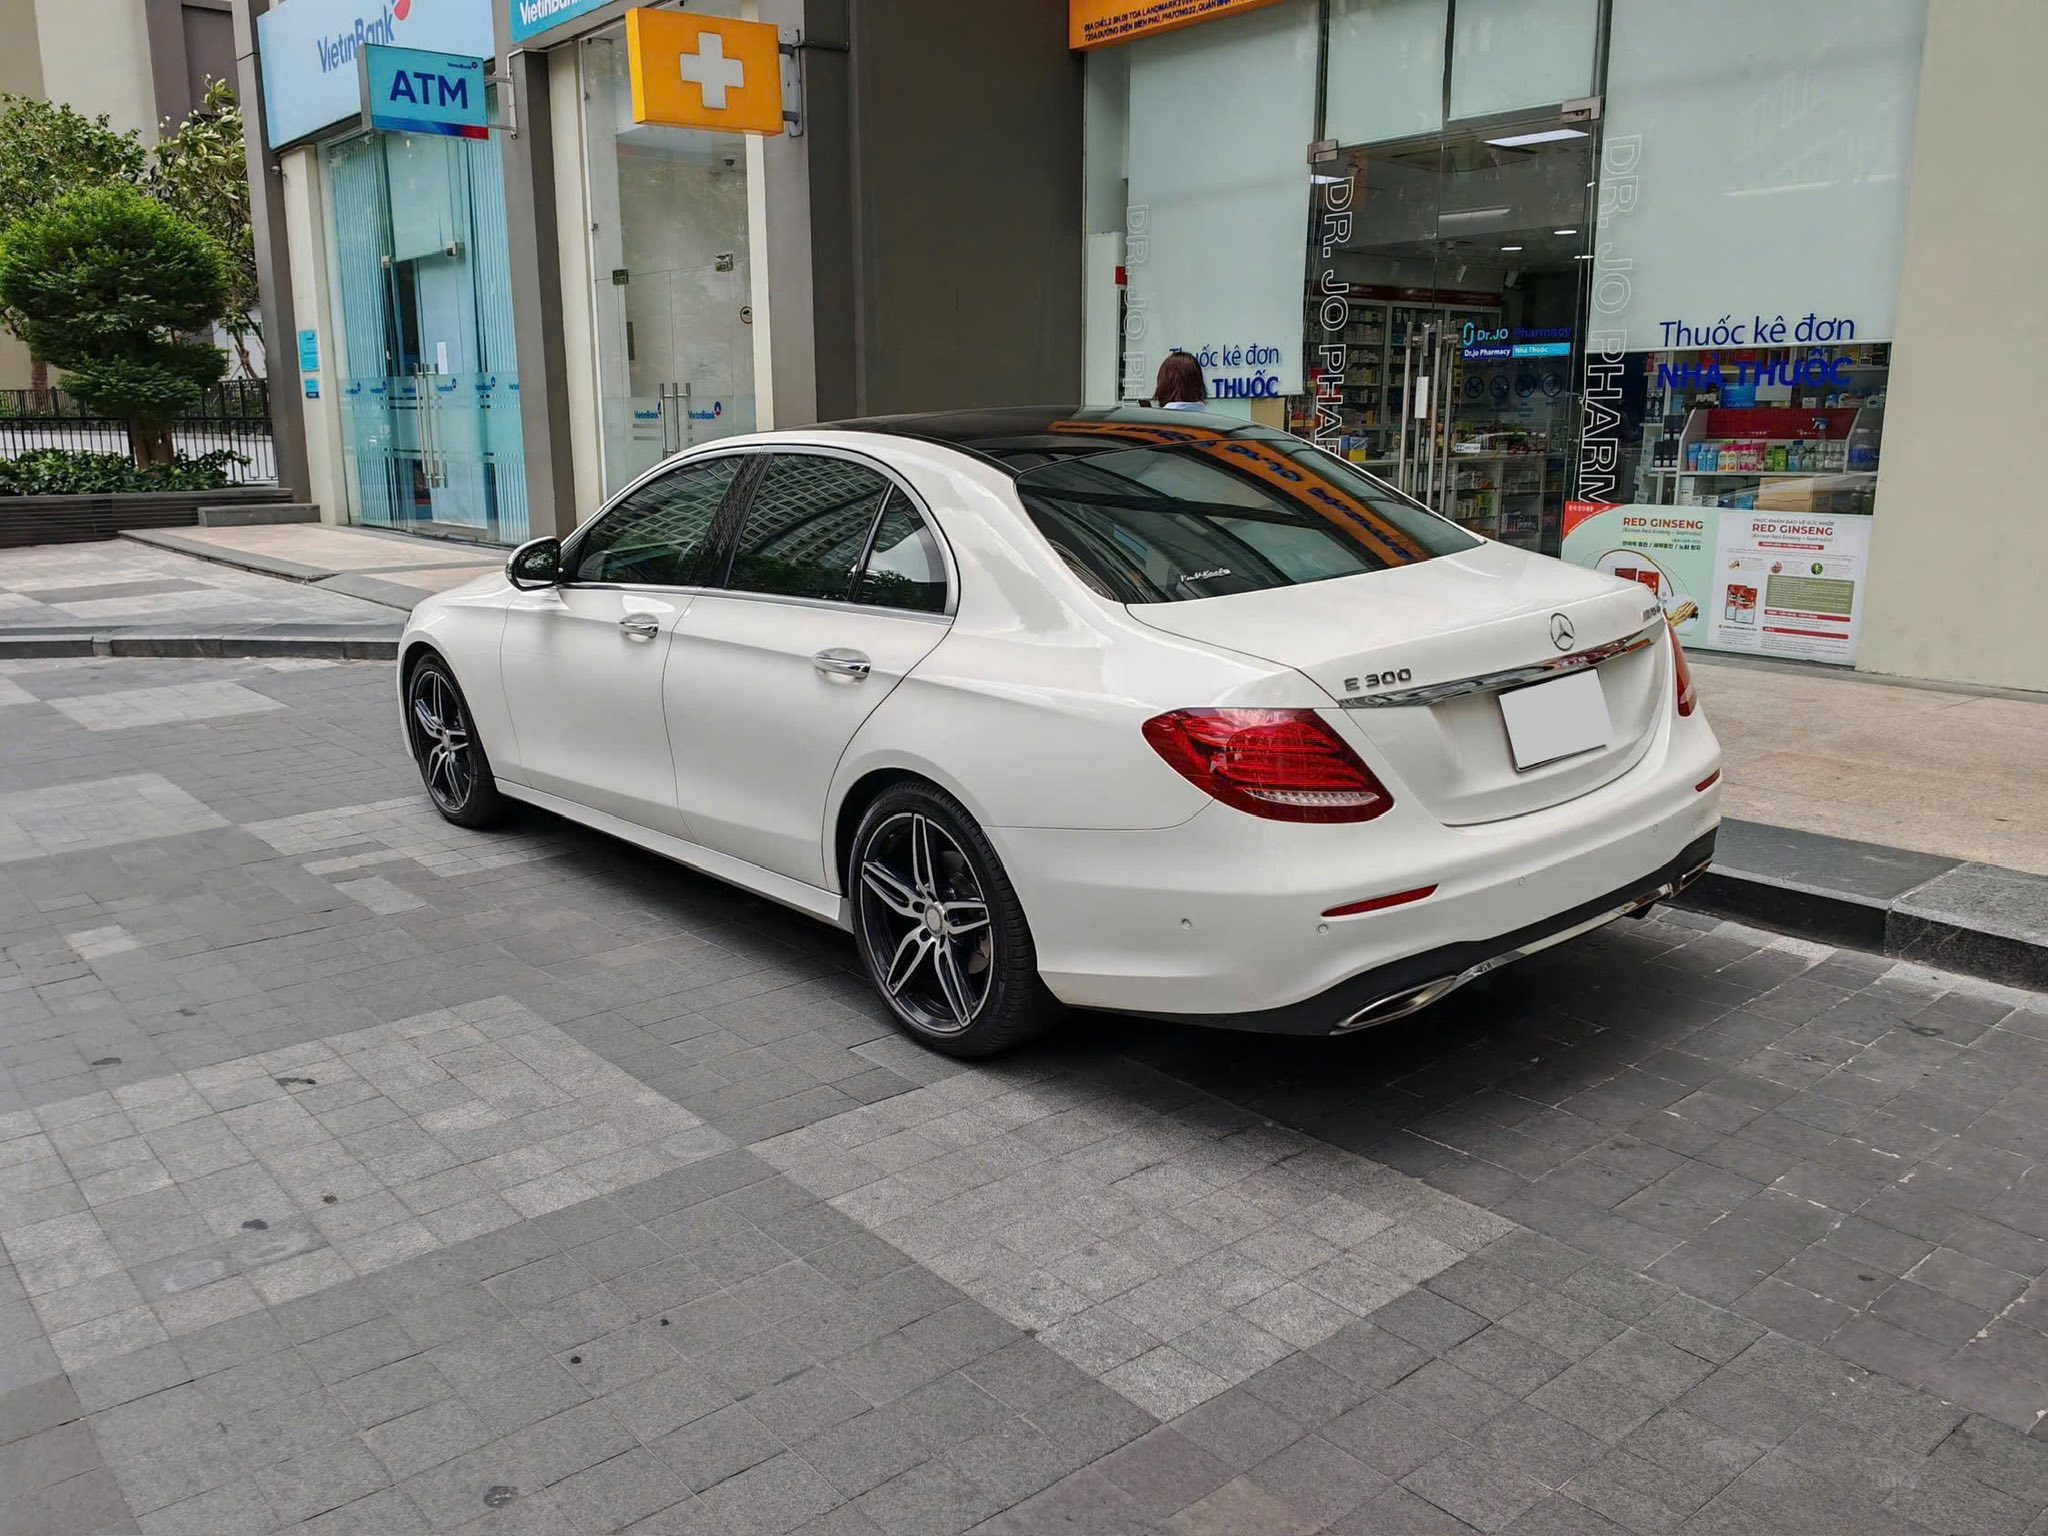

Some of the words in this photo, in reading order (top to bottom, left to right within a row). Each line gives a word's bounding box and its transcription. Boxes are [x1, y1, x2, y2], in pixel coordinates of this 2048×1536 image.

[317, 5, 395, 74] VietinBank
[389, 70, 469, 109] ATM
[1600, 134, 1642, 228] DR.
[1322, 176, 1355, 258] DR.
[1592, 242, 1632, 314] JO
[1123, 285, 1146, 340] JO
[1320, 269, 1350, 332] JO
[1477, 328, 1509, 341] Dr.JO
[1514, 327, 1572, 339] Pharmacy
[1659, 314, 1746, 347] Thuốc
[1753, 315, 1787, 344] kê
[1794, 313, 1855, 342] đơn
[1222, 344, 1241, 367] kê
[1245, 343, 1279, 365] đơn
[1480, 347, 1511, 357] Pharmacy
[1656, 351, 1723, 390] NHÀ
[1729, 347, 1853, 388] THUỐC
[1212, 369, 1279, 399] THUỐC
[1623, 517, 1647, 527] RED
[1650, 518, 1704, 530] GINSENG
[1752, 523, 1776, 533] RED
[1780, 524, 1834, 536] GINSENG
[1344, 677, 1361, 692] E
[1364, 668, 1412, 688] 300
